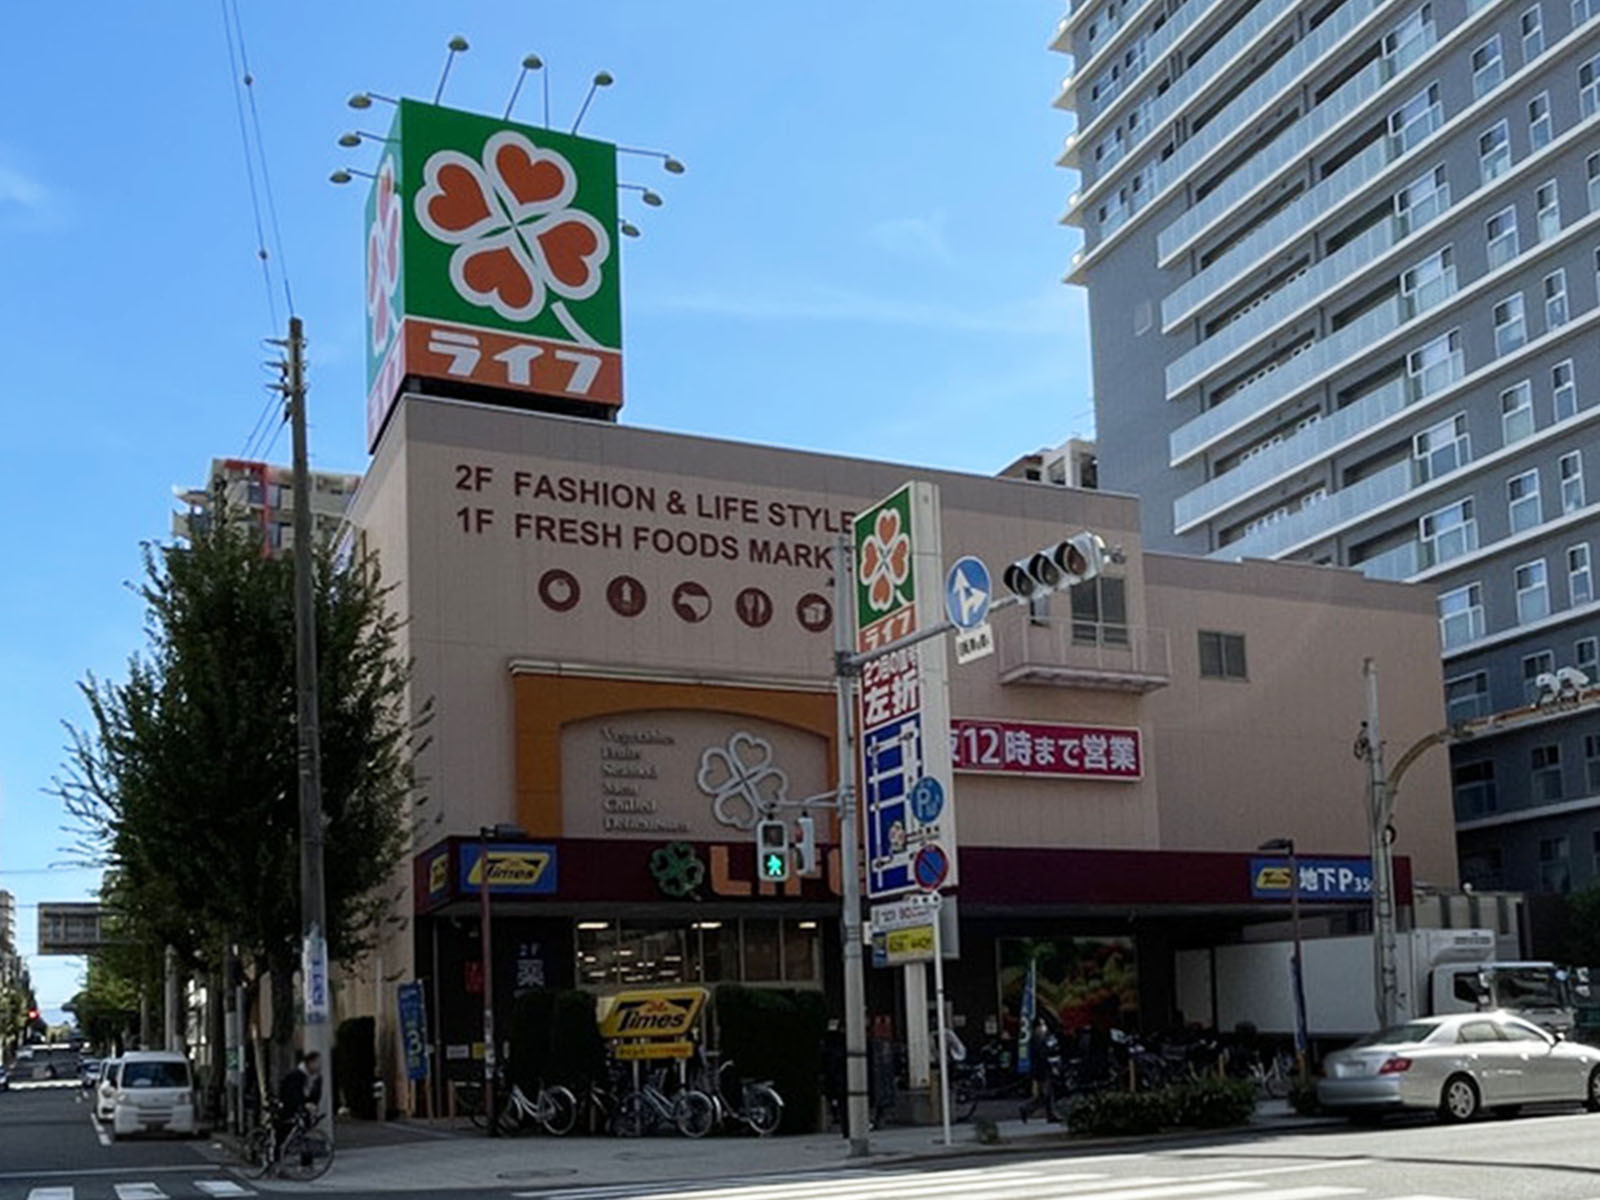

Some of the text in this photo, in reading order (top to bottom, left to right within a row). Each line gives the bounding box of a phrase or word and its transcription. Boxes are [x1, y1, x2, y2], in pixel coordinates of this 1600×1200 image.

[429, 329, 601, 394] ライフ
[455, 464, 493, 493] 2F
[514, 471, 655, 513] FASHION
[666, 490, 686, 516] &
[697, 494, 759, 523] LIFE
[456, 506, 493, 534] 1F
[514, 513, 622, 549] FRESH
[633, 526, 739, 561] FOODS
[864, 669, 919, 726] 左折
[617, 1008, 686, 1032] Times
